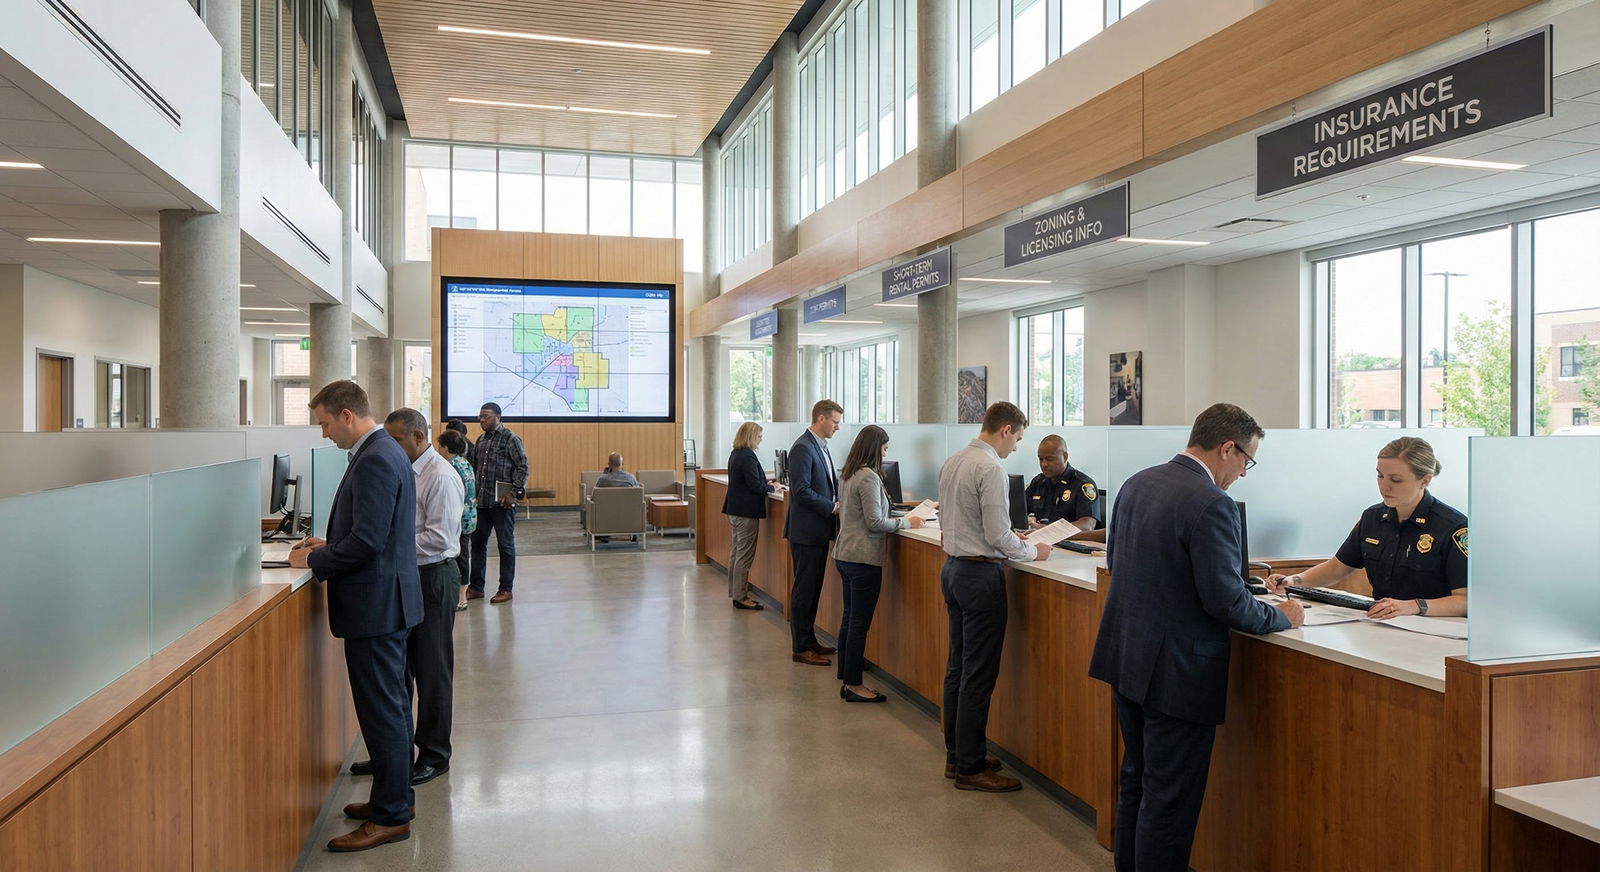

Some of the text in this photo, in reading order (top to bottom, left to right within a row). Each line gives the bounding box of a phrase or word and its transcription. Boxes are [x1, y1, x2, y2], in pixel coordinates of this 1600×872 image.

[1313, 74, 1454, 144] INSURANCE
[1293, 99, 1482, 177] REQUIREMENTS
[1021, 221, 1103, 257] LICENSING INFO
[1034, 206, 1085, 236] ZONING &
[888, 271, 940, 296] RENTAL PERMITS
